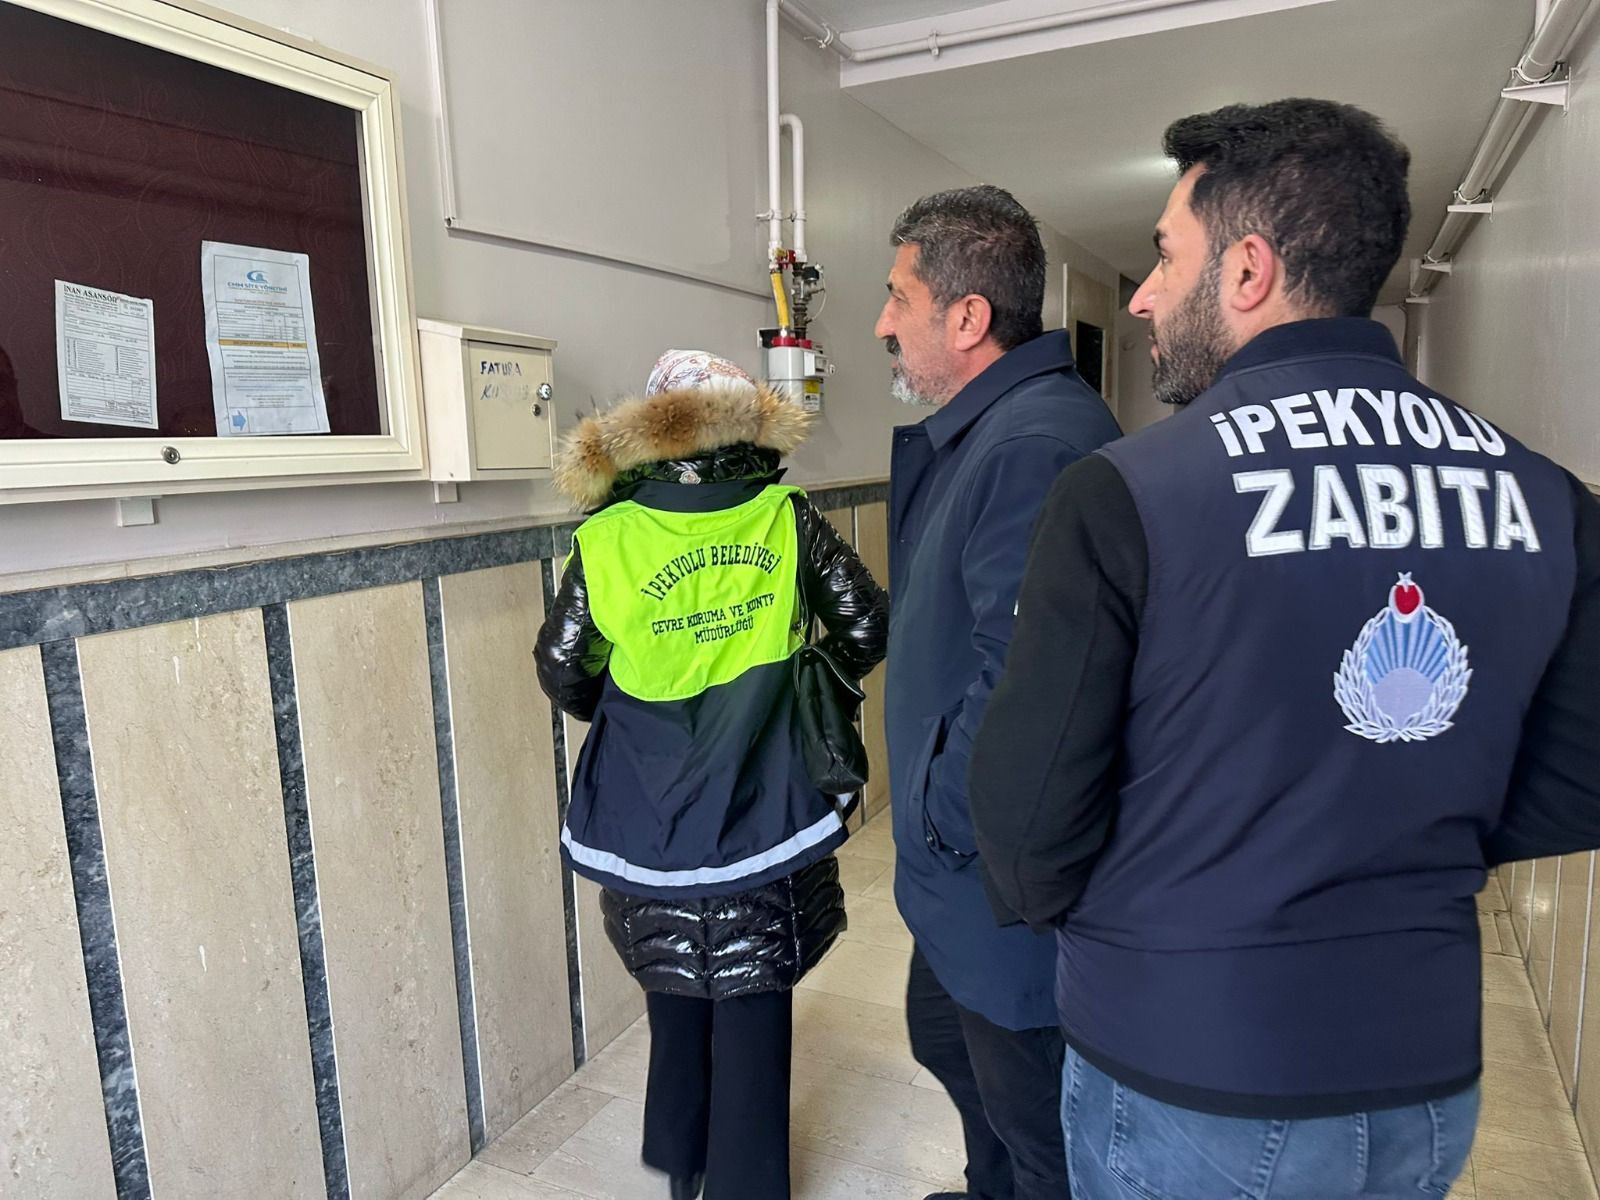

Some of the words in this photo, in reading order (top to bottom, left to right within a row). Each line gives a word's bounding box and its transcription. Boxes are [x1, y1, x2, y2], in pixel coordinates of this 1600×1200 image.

[480, 361, 522, 376] FATURA
[1232, 463, 1542, 557] ZABITA
[640, 548, 706, 601] İPEKYOLU
[710, 542, 782, 575] BELEDİYESİ
[651, 617, 684, 636] ÇEVRE
[687, 608, 727, 628] KORUMA
[729, 604, 744, 618] VE
